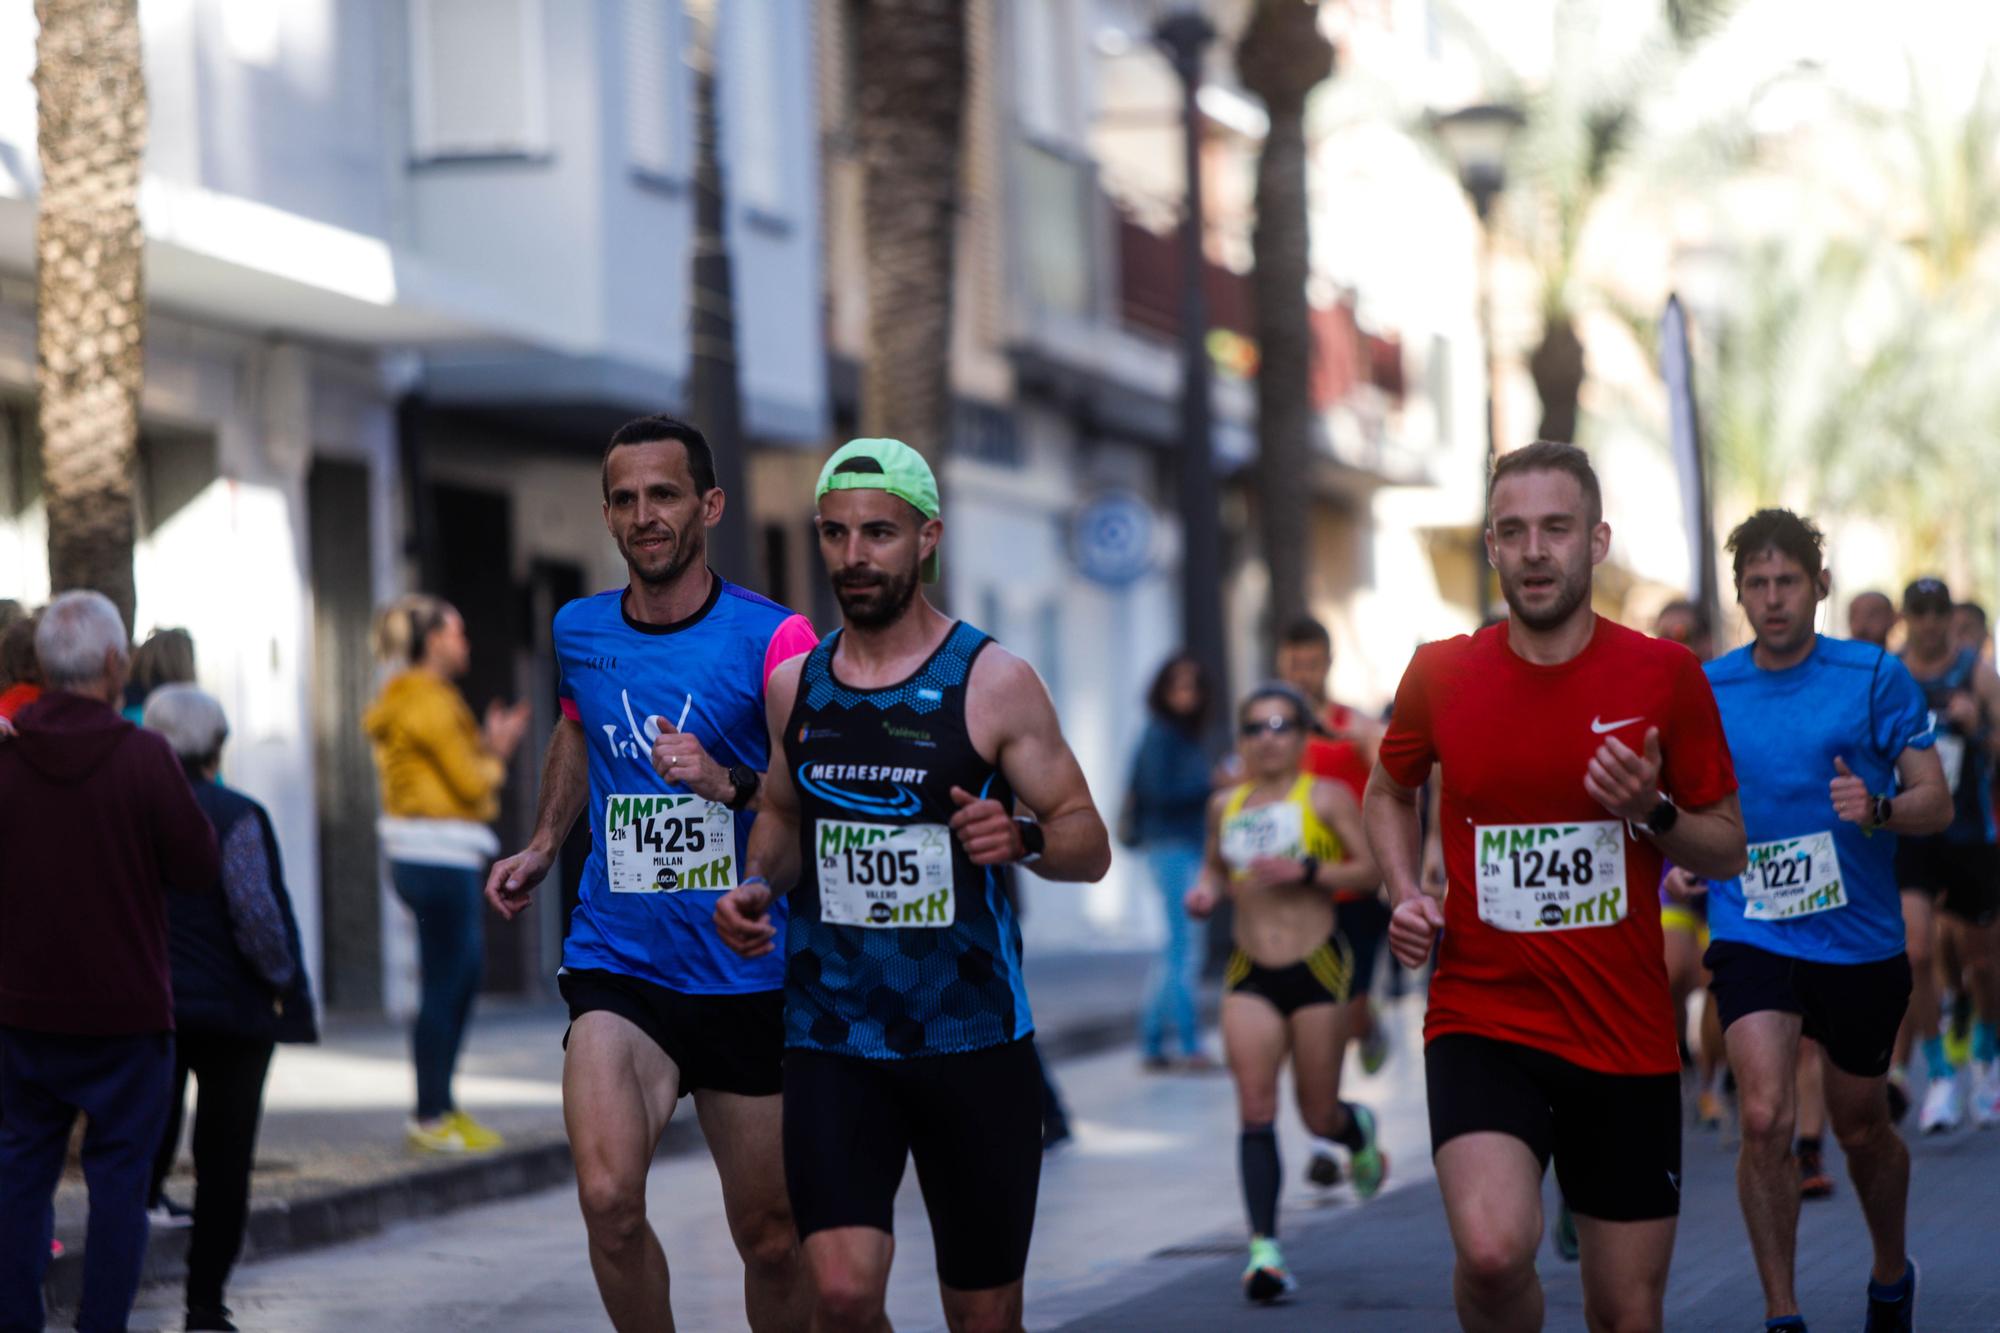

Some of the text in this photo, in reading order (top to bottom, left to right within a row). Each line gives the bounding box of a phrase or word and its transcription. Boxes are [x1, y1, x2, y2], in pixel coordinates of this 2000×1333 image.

[811, 764, 928, 784] METAESPORT
[632, 817, 705, 852] 1425
[653, 857, 683, 866] MILLAN
[843, 848, 919, 886] 1305
[1508, 847, 1593, 888] 1248
[1760, 855, 1811, 890] 1227
[1534, 891, 1570, 902] CARLOS
